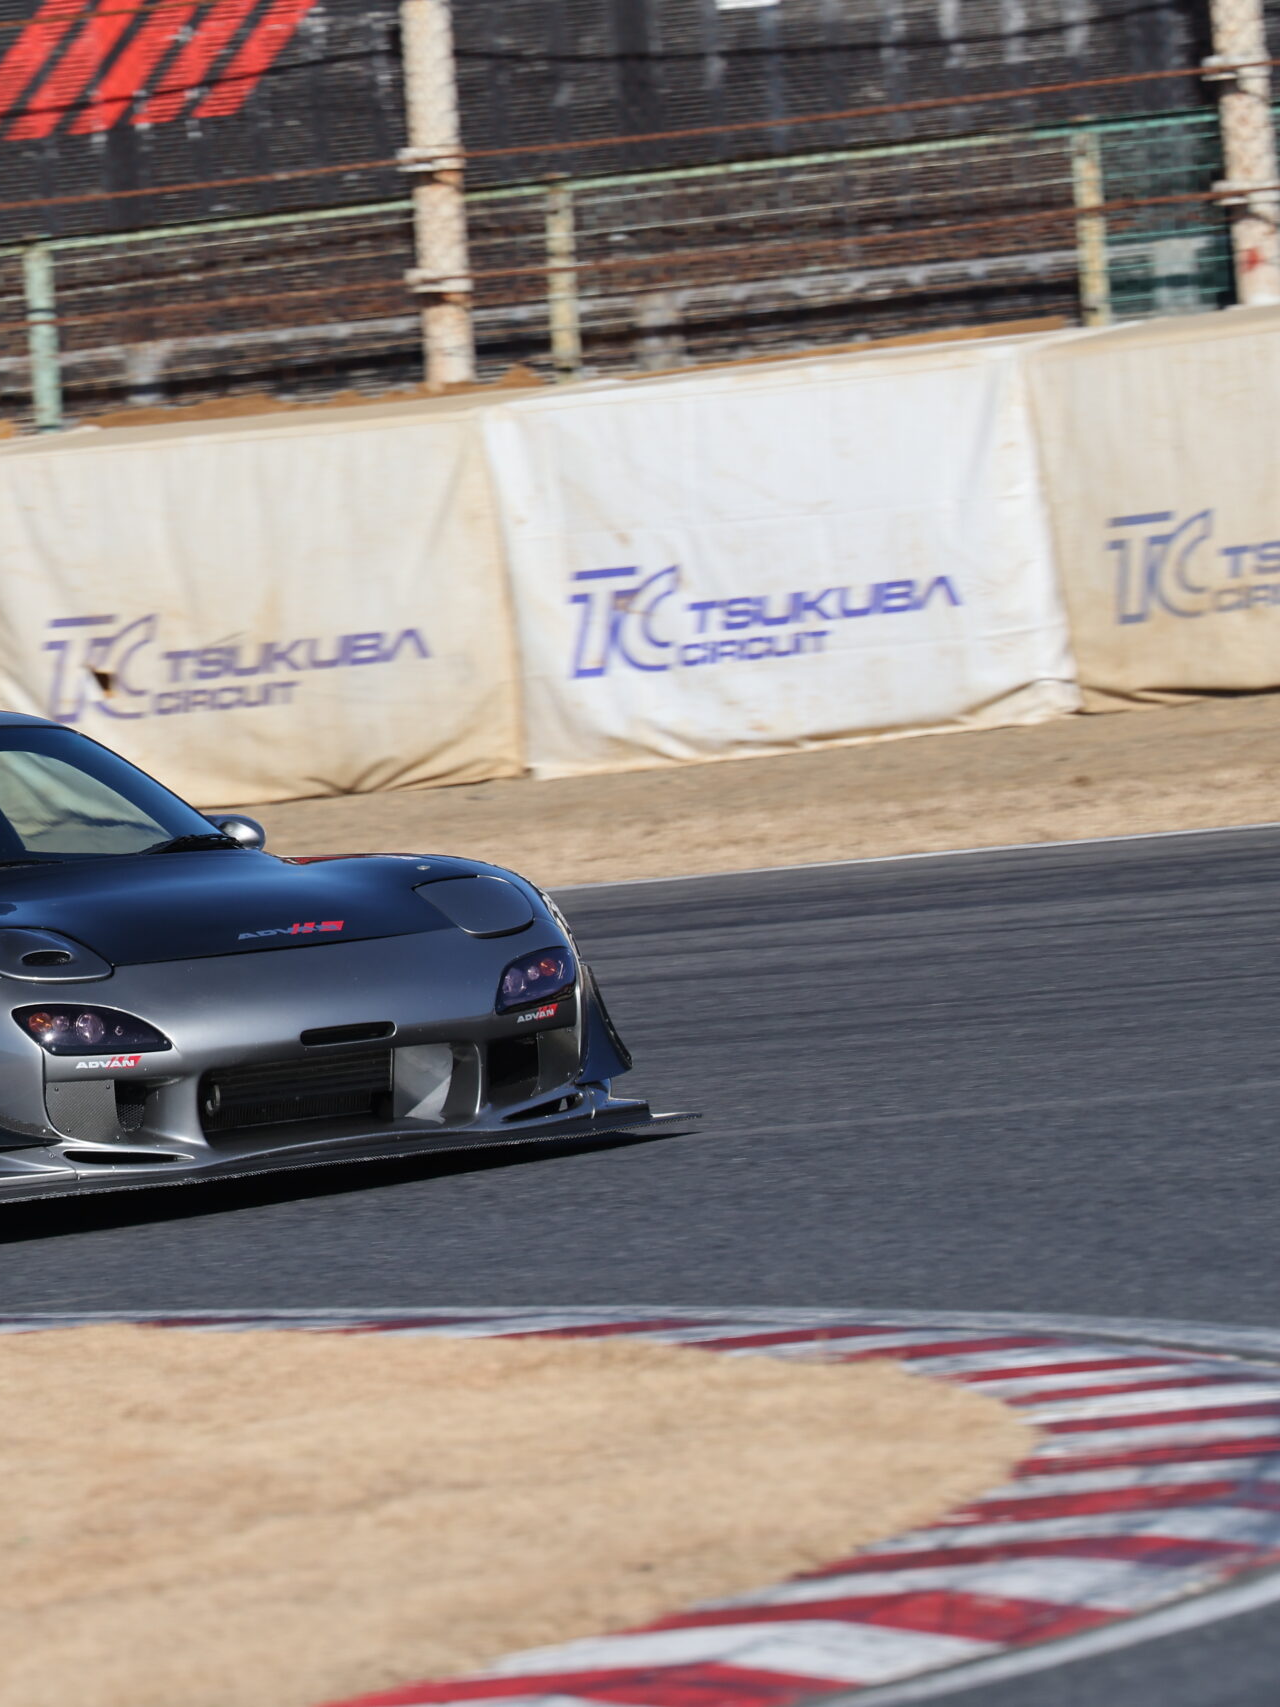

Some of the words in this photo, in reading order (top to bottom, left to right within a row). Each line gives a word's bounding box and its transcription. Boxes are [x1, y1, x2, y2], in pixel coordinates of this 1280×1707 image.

[688, 575, 961, 634] TSUKUBA
[163, 628, 431, 682] TSUKUBA
[680, 630, 830, 667] CIRCUIT
[154, 681, 301, 715] CIRCUIT
[517, 1008, 554, 1024] ADVAN
[76, 1057, 135, 1070] ADVAN
